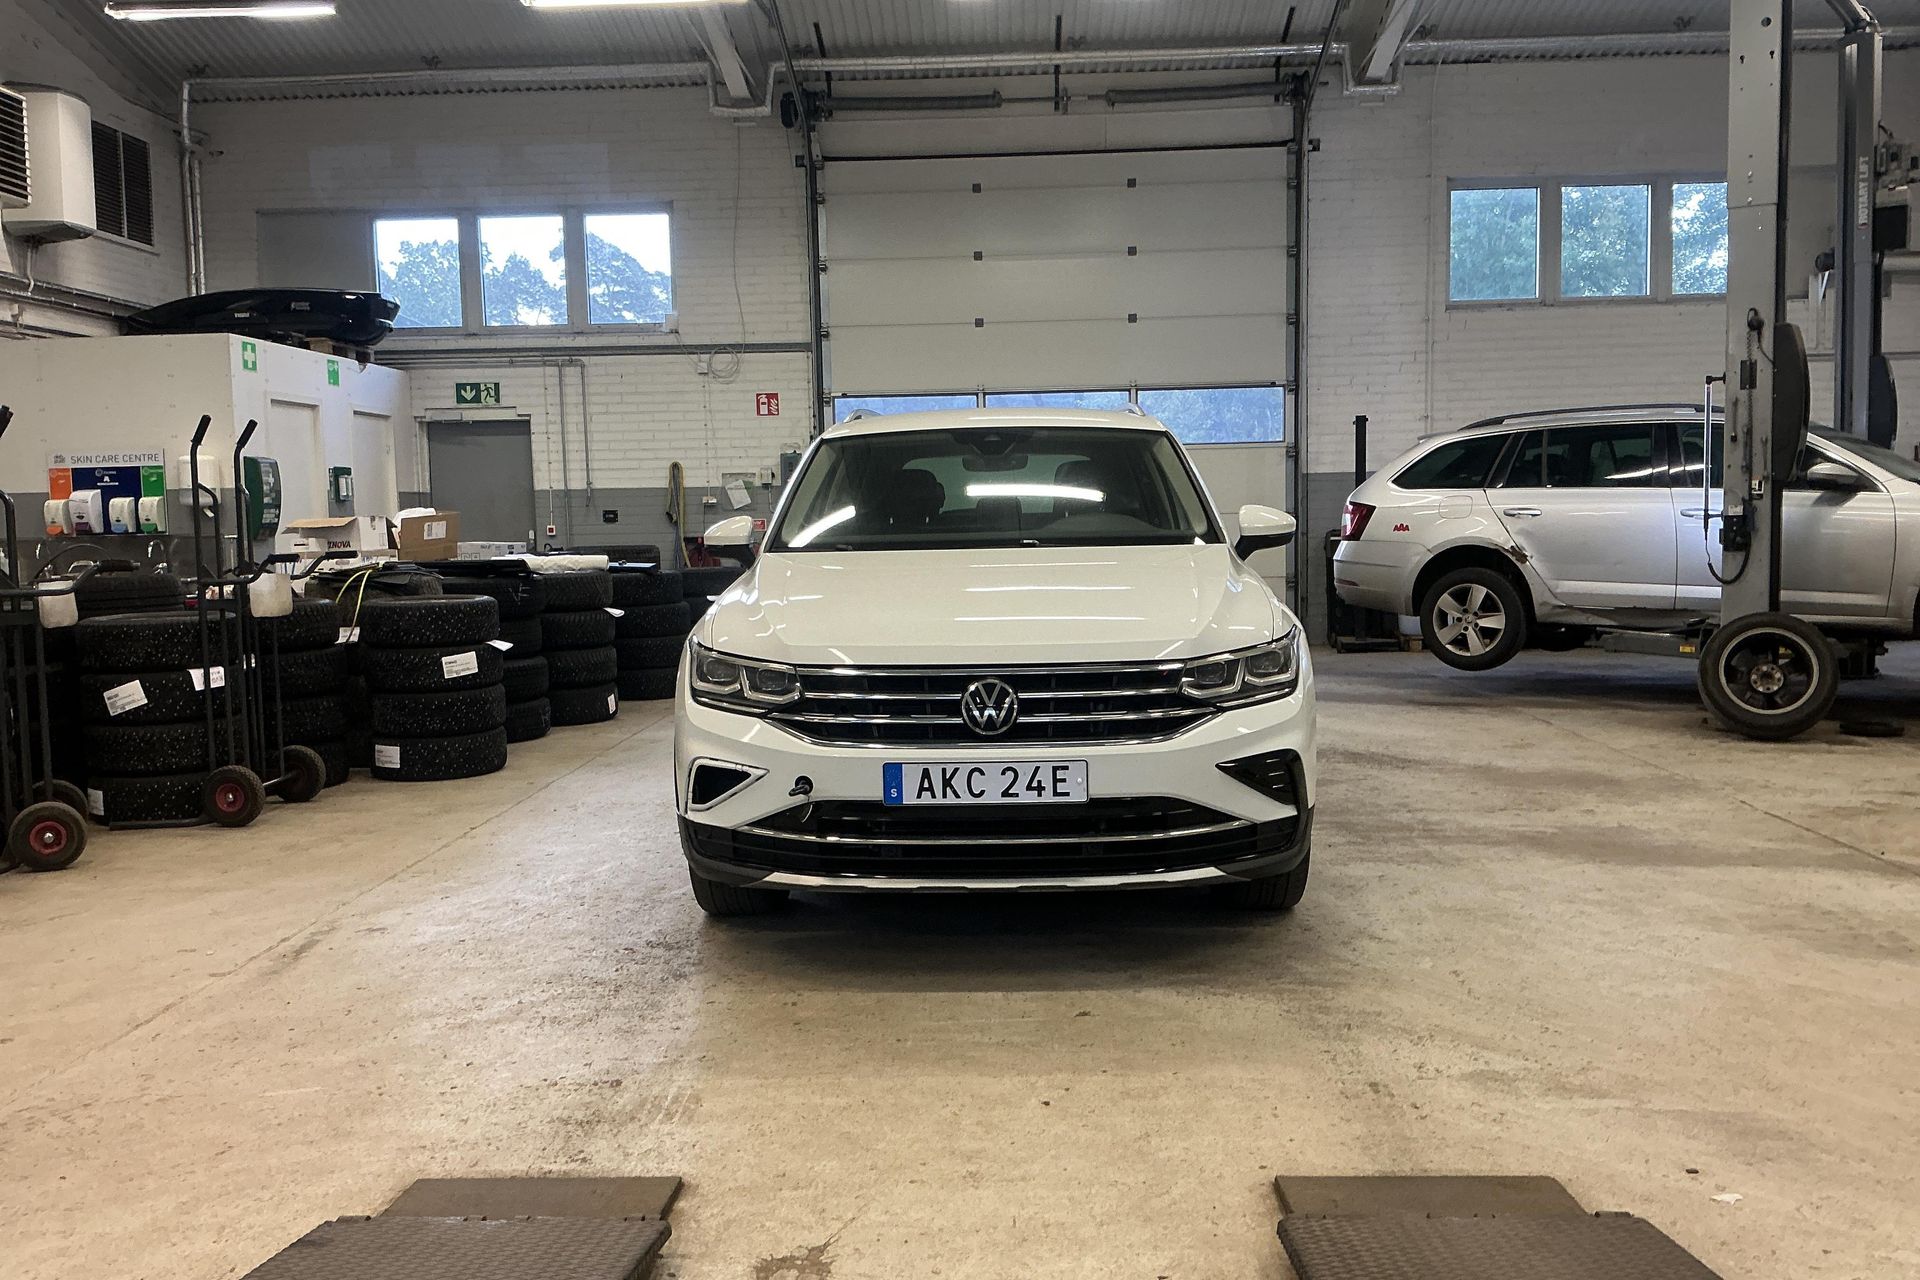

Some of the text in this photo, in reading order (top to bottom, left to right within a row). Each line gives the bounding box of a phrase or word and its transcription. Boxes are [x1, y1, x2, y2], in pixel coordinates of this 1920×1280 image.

[1858, 156, 1869, 224] ROTARY LIFT
[70, 455, 93, 465] SKIN
[95, 454, 120, 463] CARE
[122, 453, 160, 463] CENTRE
[915, 765, 1071, 800] AKC 24E
